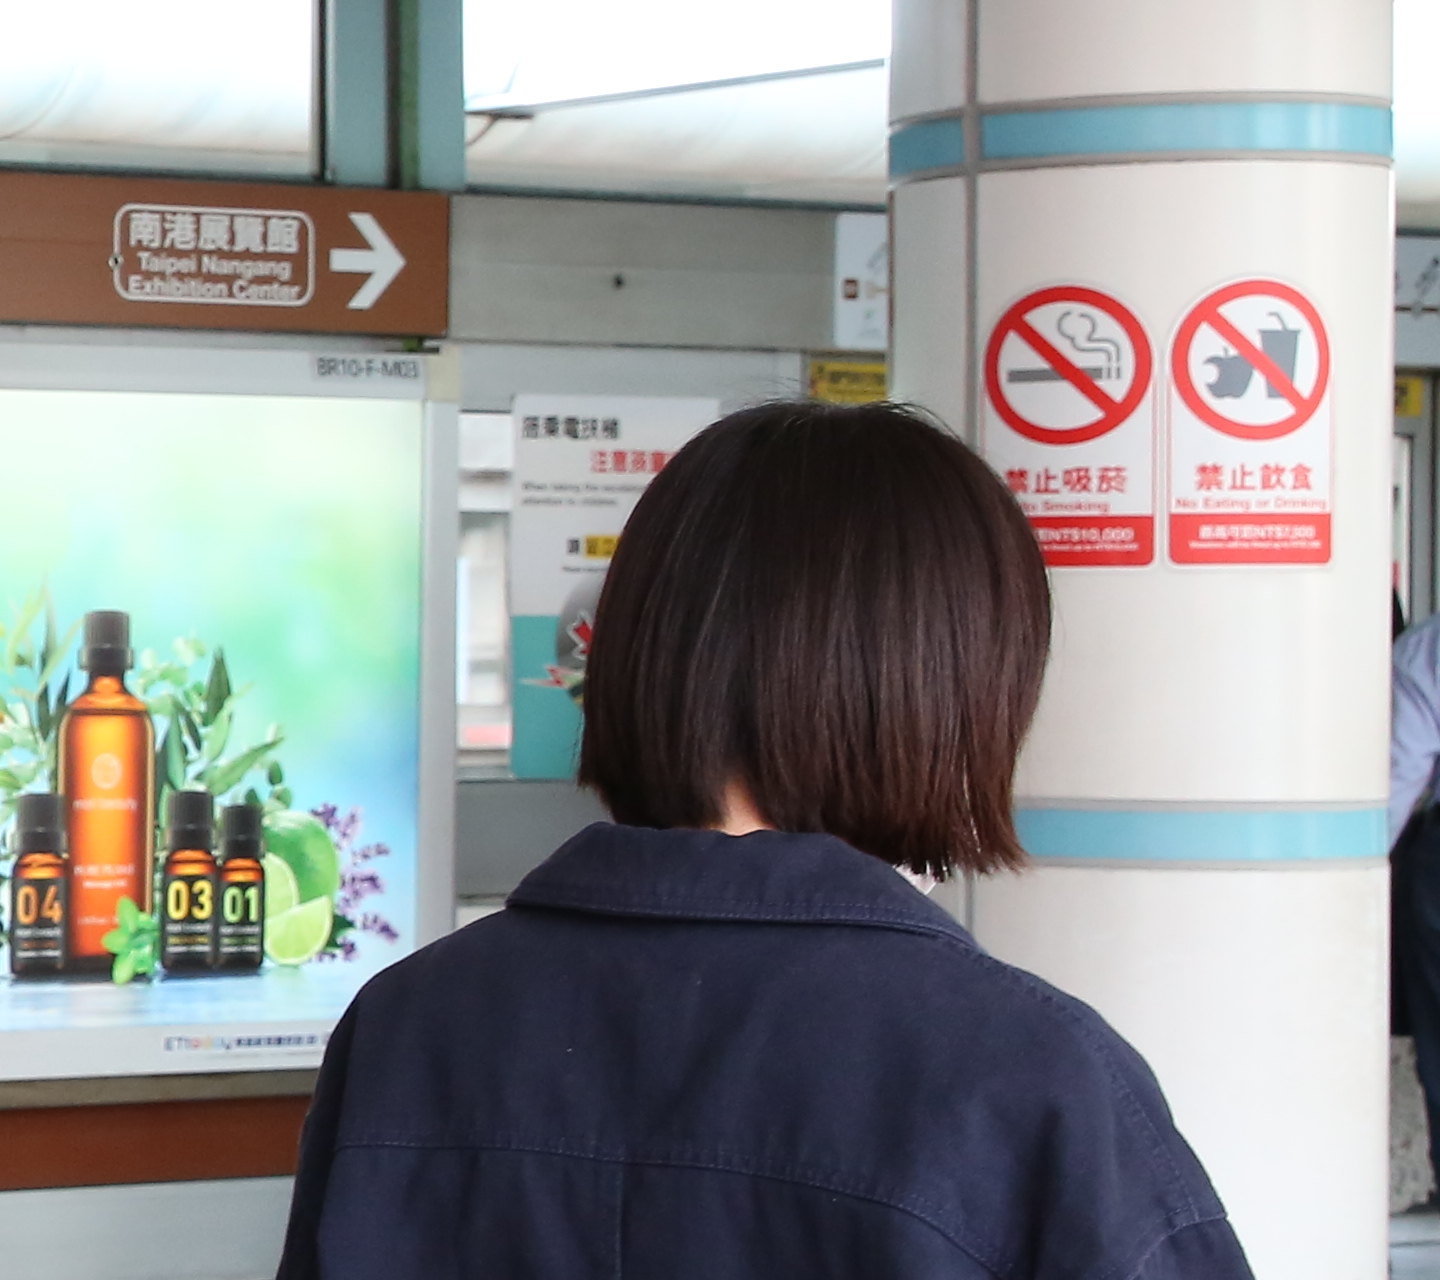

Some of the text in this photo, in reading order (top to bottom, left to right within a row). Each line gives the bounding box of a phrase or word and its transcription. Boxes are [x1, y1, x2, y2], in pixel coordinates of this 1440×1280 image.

[129, 212, 300, 254] 南港展覽館
[136, 251, 293, 281] Taipei Nangang
[128, 274, 303, 301] Exhibition Center
[1006, 466, 1127, 494] 禁止吸菸
[1196, 463, 1313, 491] 禁止飲食
[1044, 501, 1110, 514] Smoking
[1176, 498, 1326, 511] No Eating or Drinking
[16, 885, 64, 925] 04
[166, 879, 213, 920] 03
[222, 886, 259, 924] 01
